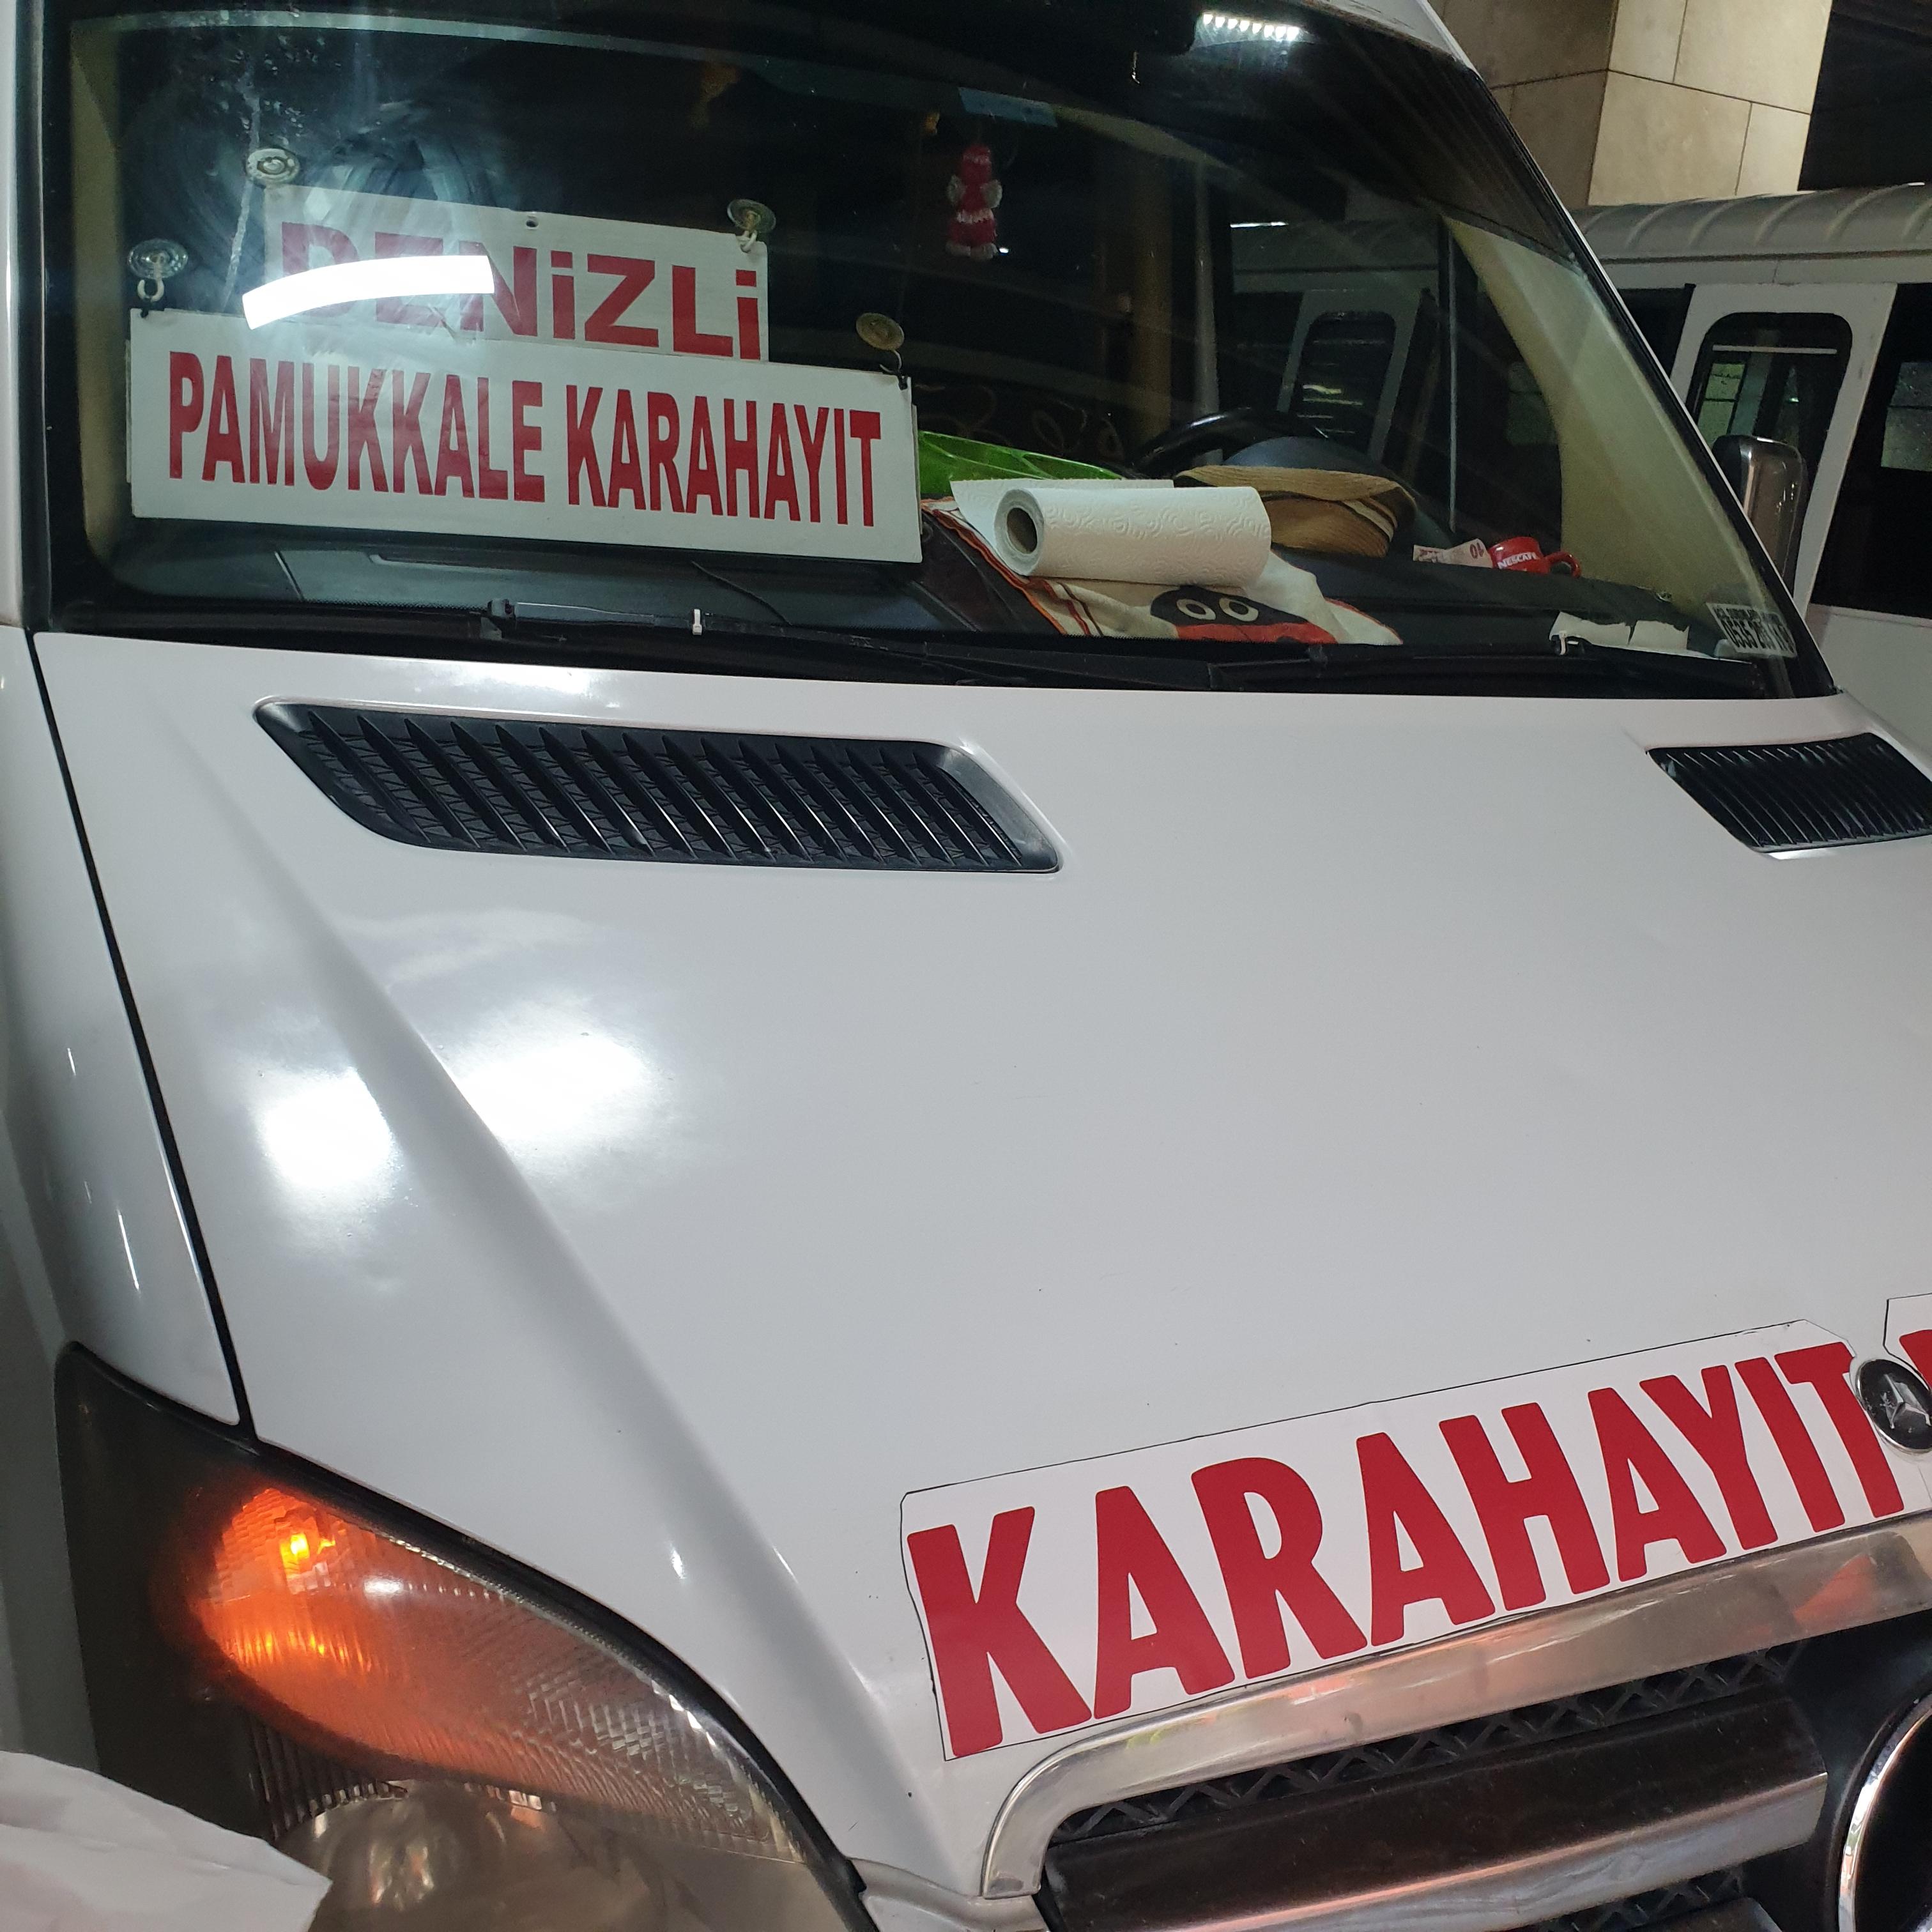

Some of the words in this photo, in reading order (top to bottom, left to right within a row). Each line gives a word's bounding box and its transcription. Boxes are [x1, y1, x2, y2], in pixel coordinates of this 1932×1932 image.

[169, 351, 545, 503] PAMUKKALE
[565, 385, 882, 527] KARAHAYIT
[906, 1342, 1905, 1759] KARAHAYIT
